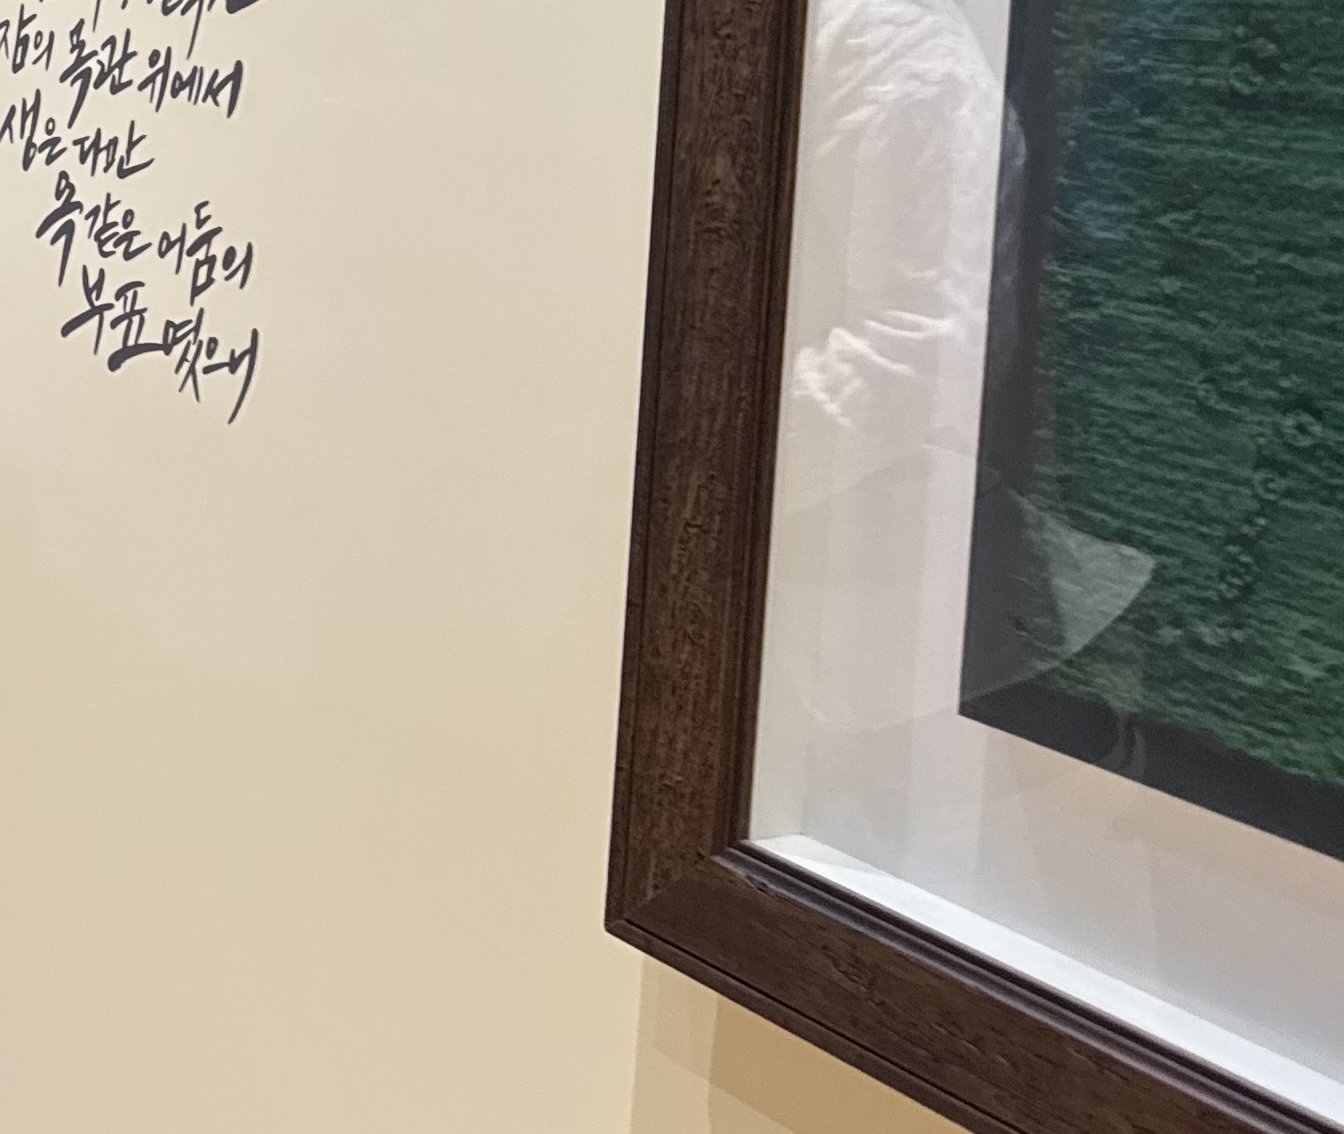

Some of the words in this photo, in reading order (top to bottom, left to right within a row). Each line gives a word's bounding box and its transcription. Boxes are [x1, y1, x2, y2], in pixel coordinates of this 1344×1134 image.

[137, 46, 244, 119] 위에서
[71, 119, 156, 180] 다만
[156, 199, 255, 307] 어둠의
